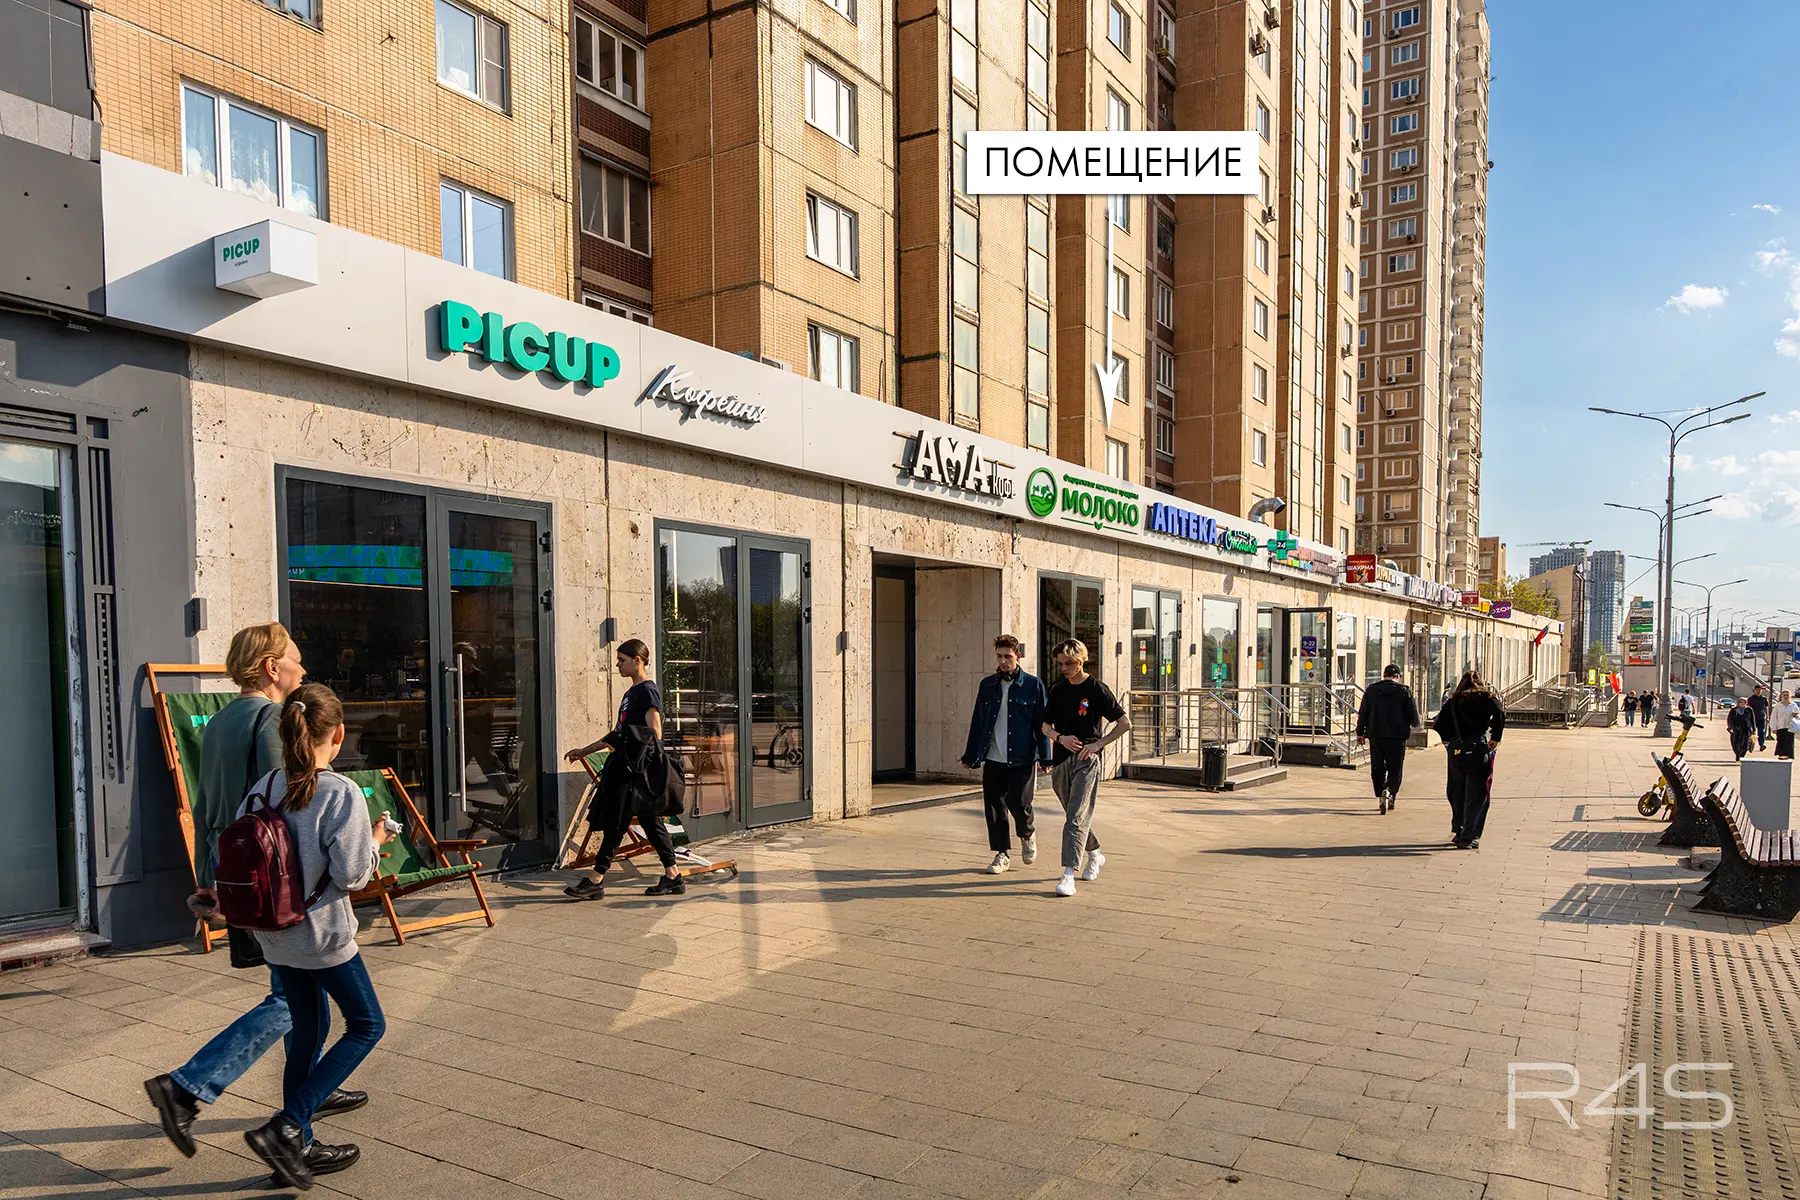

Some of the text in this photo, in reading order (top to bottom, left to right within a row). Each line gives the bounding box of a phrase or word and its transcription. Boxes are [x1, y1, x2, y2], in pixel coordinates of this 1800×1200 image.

[223, 238, 260, 262] PICUP
[440, 300, 620, 388] PICUP
[648, 364, 768, 424] Кофейня
[1061, 487, 1140, 527] МОЛОКО
[1153, 502, 1218, 545] АПТЕКА
[1277, 541, 1286, 549] 24
